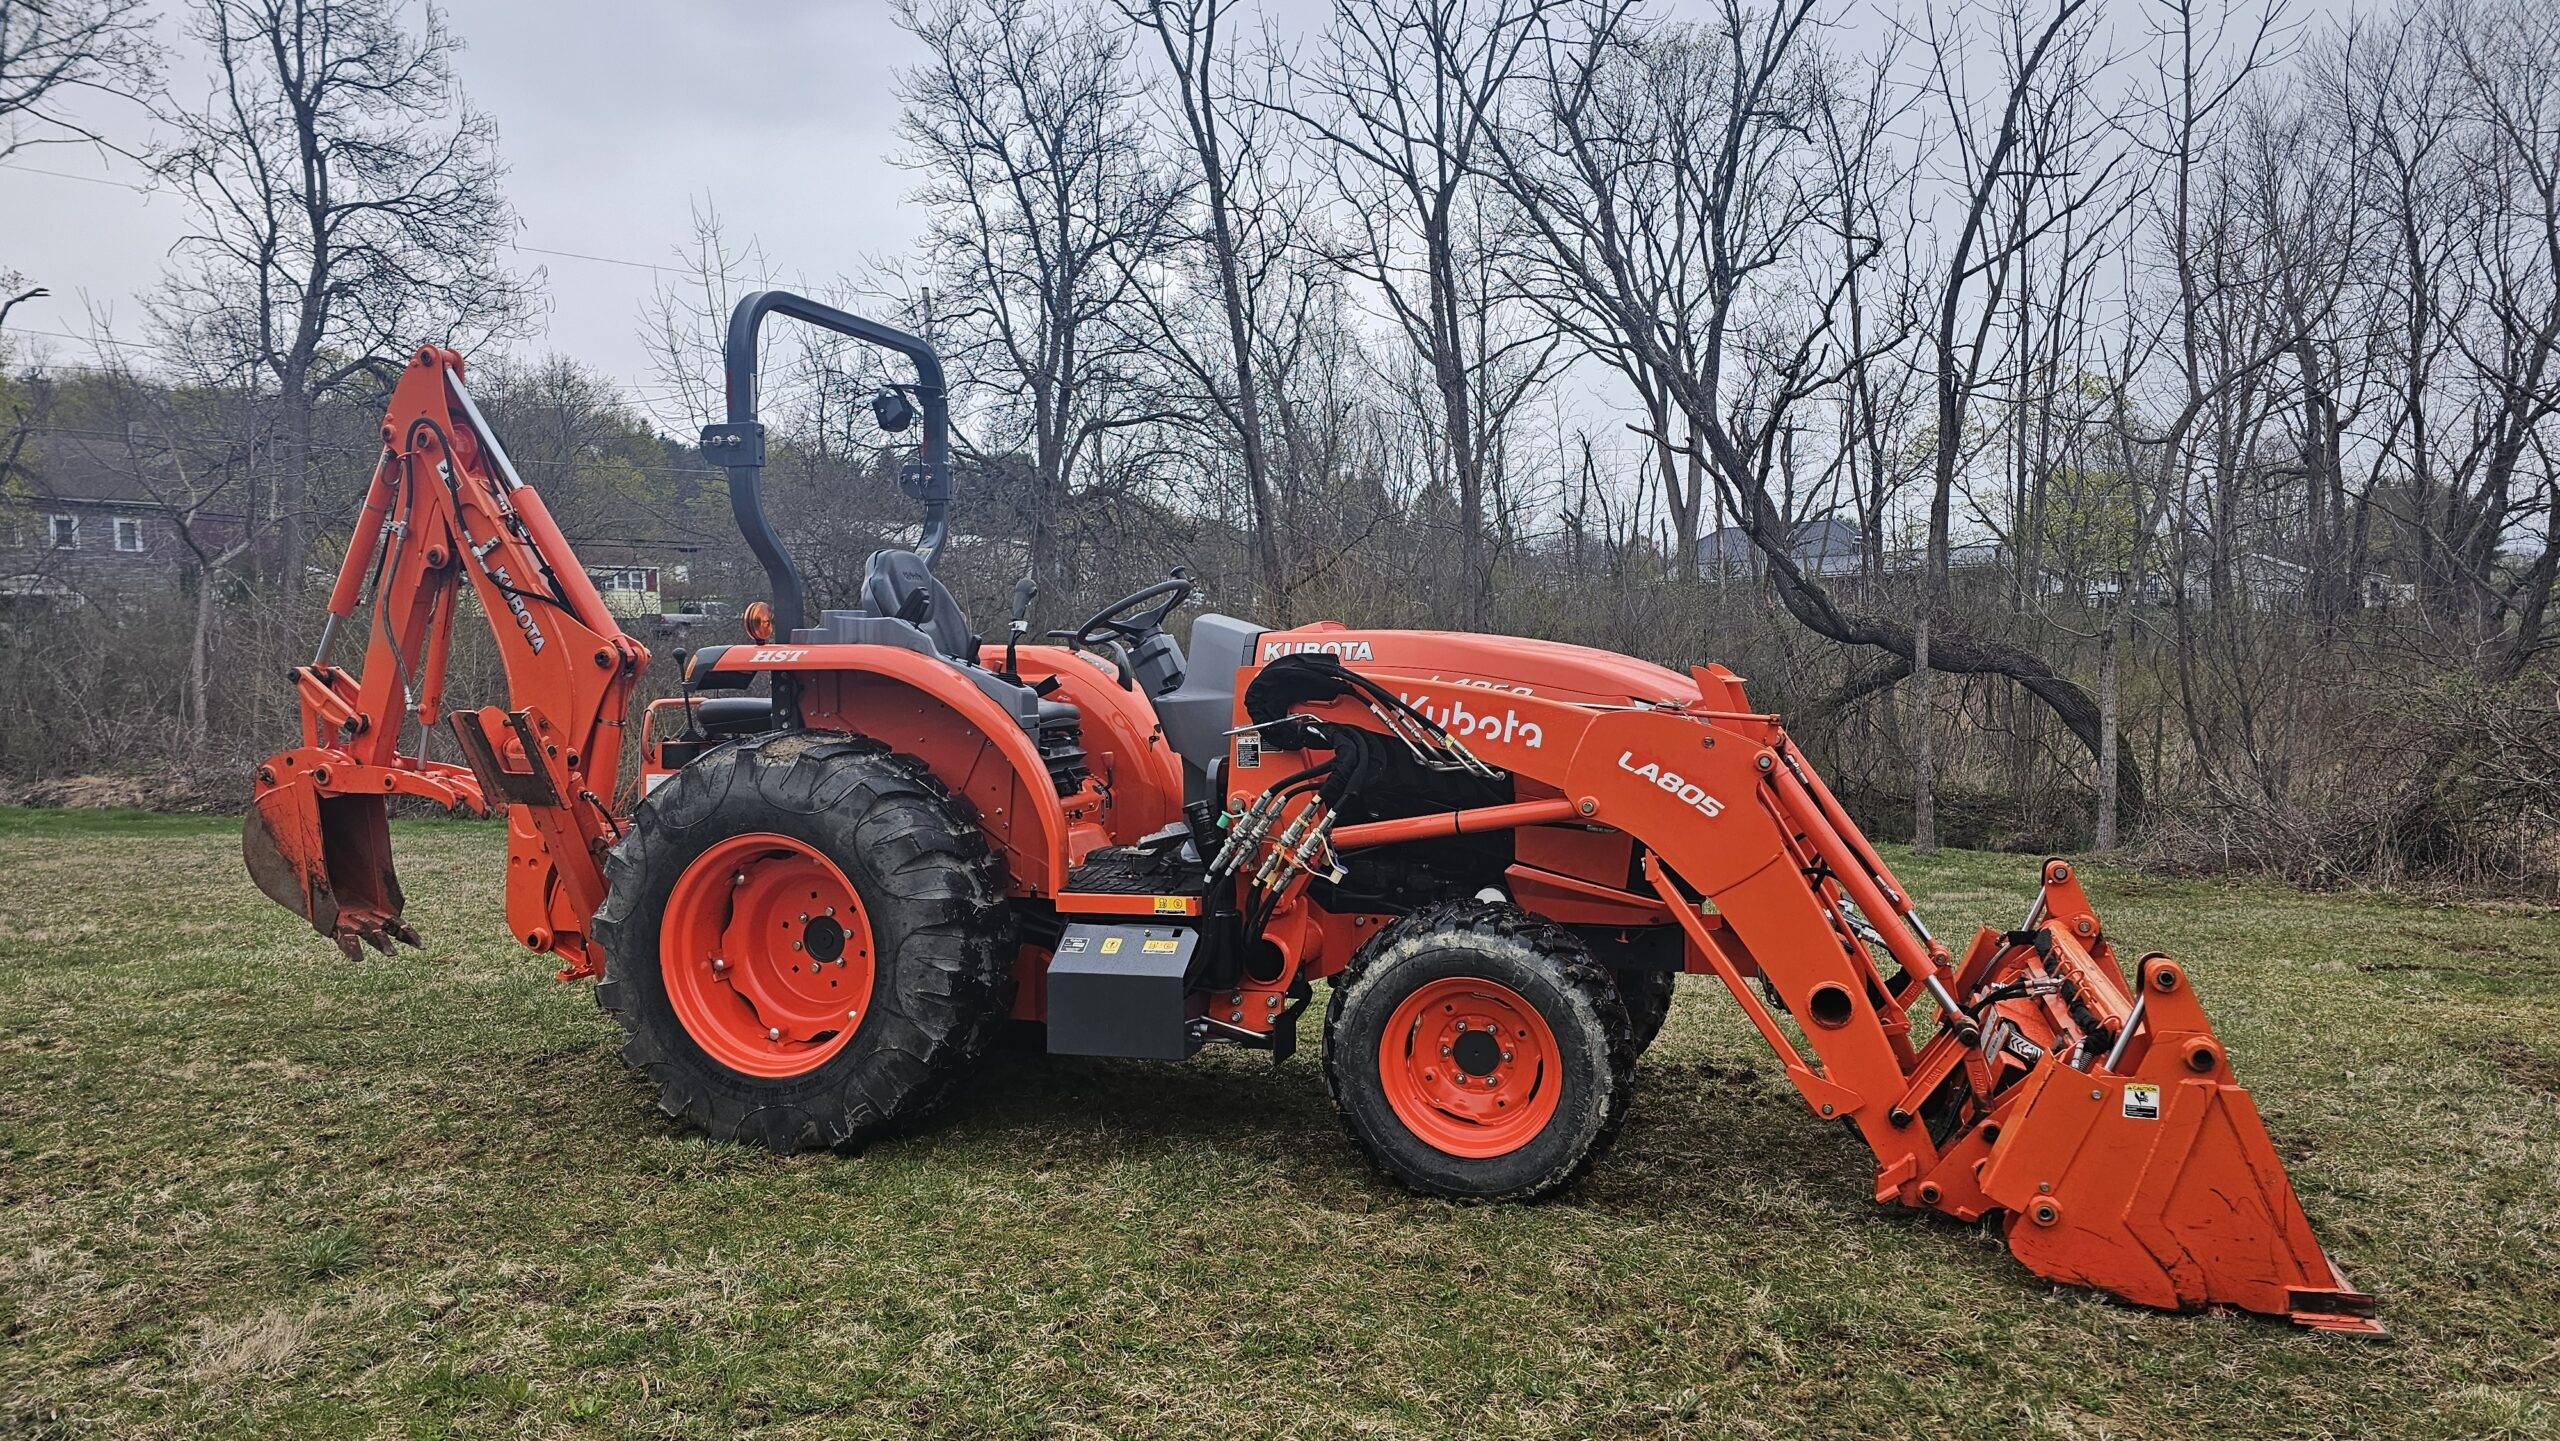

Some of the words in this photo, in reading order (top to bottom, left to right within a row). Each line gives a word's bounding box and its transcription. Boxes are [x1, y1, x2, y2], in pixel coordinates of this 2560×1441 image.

[493, 565, 545, 656] KUBOTA
[749, 650, 808, 662] HST
[1263, 641, 1374, 661] KUBOTA
[1399, 692, 1543, 748] Kubota
[1618, 751, 1726, 817] LA805
